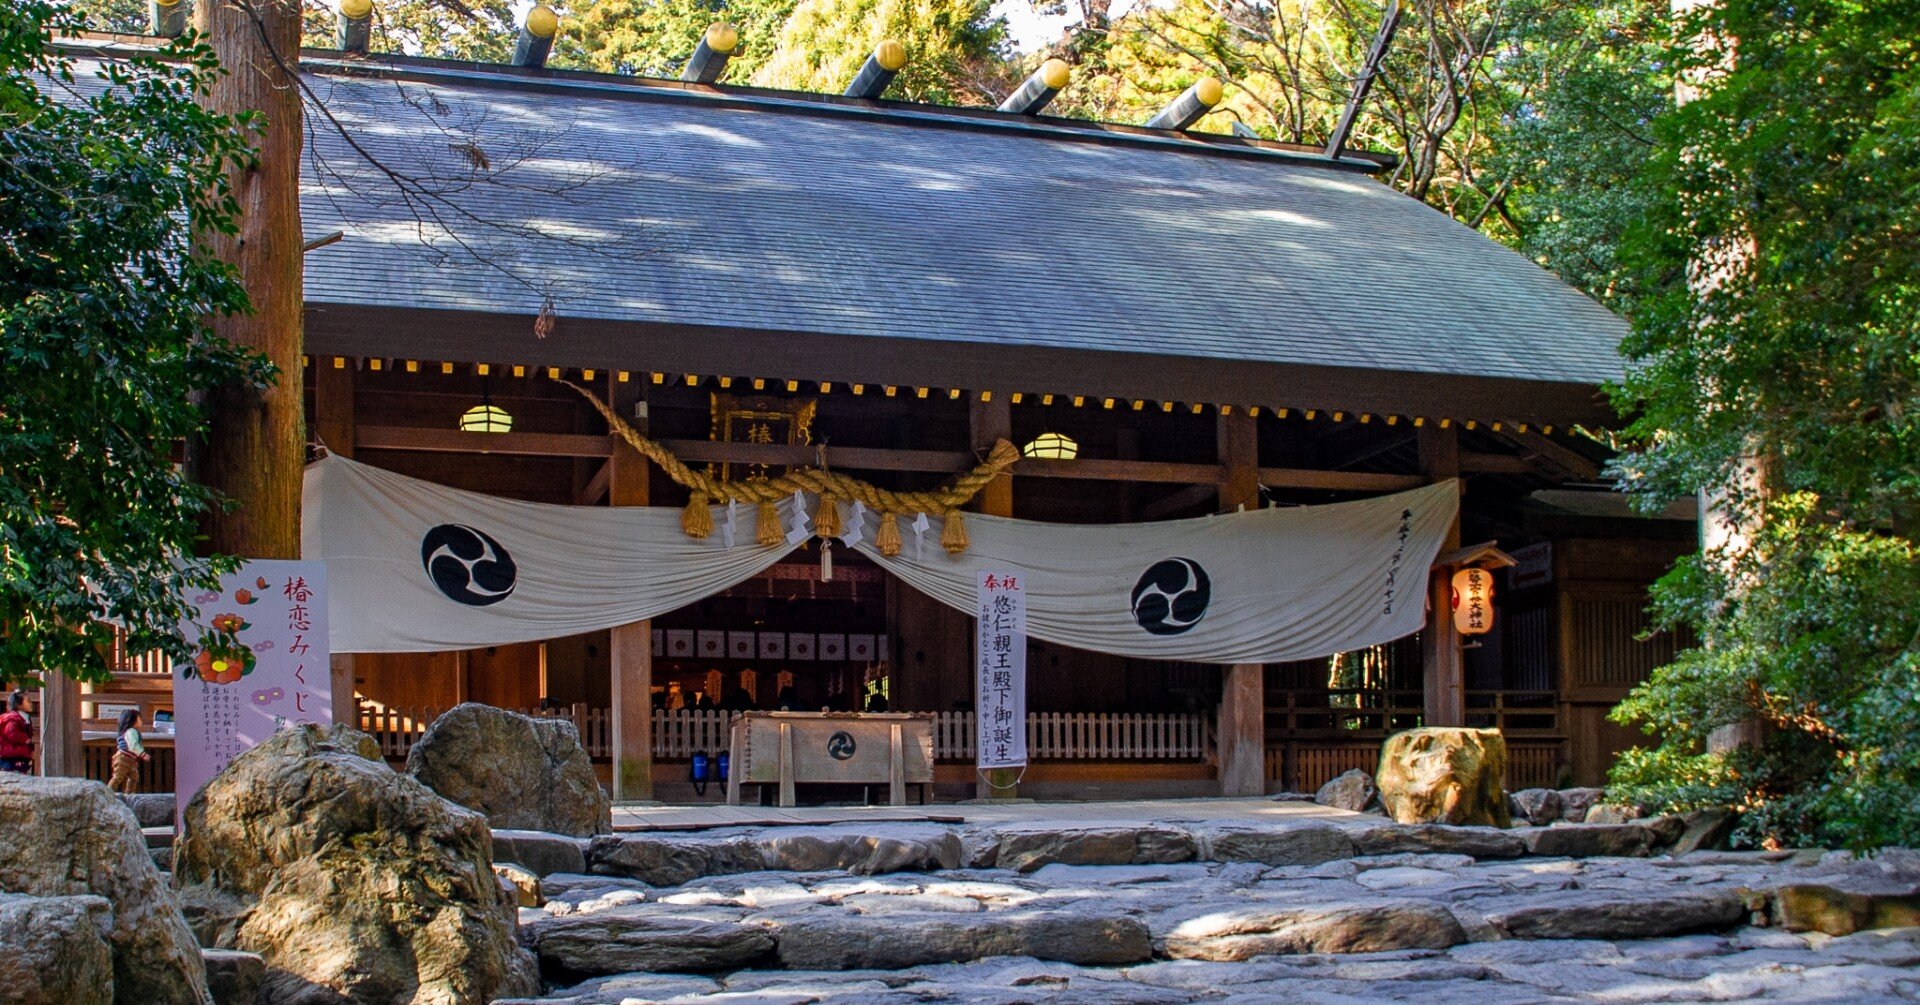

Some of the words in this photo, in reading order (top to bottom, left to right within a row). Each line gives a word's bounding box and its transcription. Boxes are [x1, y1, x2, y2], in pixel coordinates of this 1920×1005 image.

[984, 573, 1020, 593] 奉祝
[981, 604, 992, 764] お健やかなご成長をお祈り申し上げます
[992, 595, 1013, 763] 悠仁親王殿下御誕生
